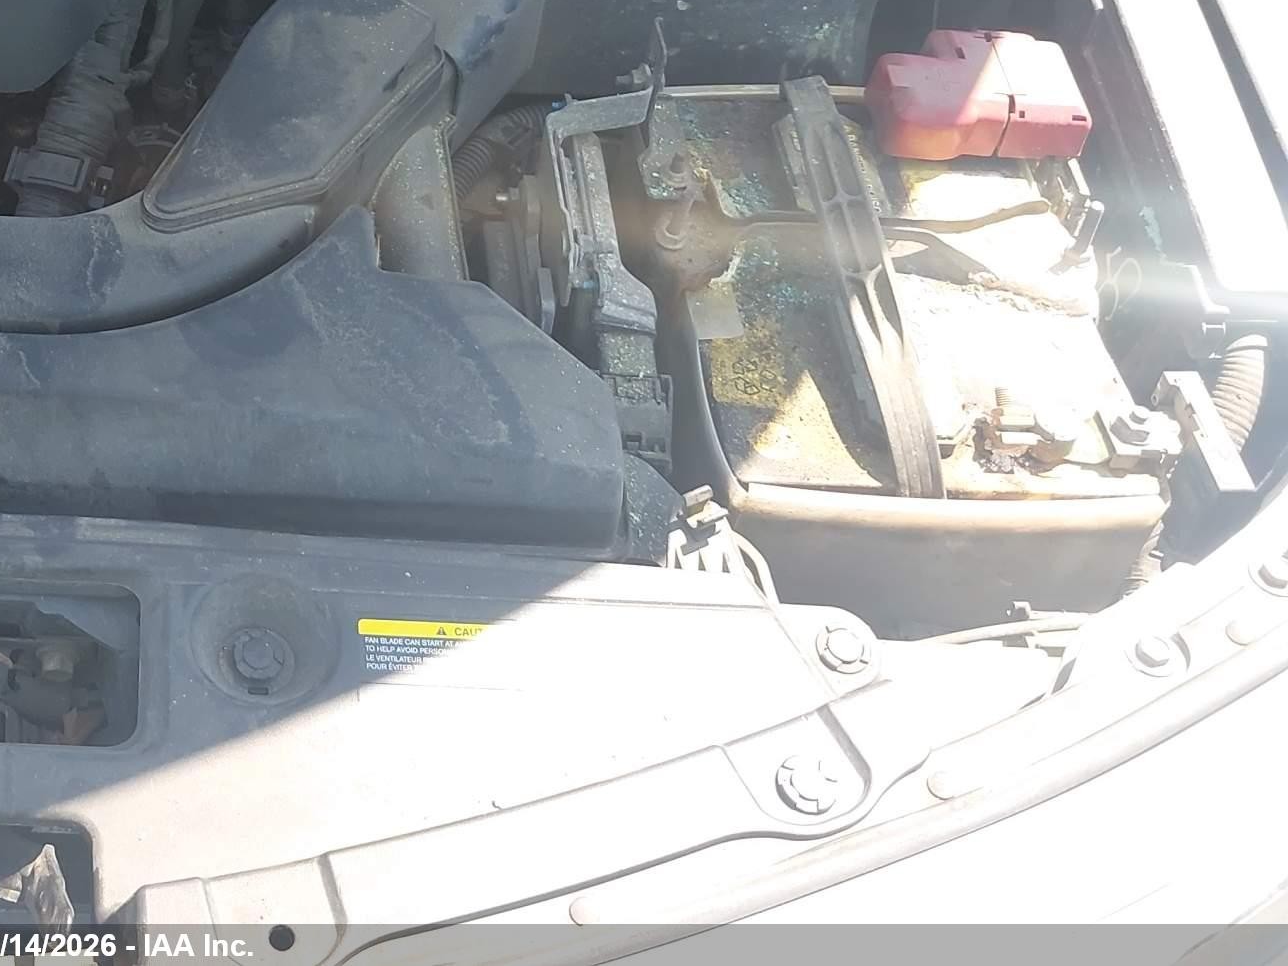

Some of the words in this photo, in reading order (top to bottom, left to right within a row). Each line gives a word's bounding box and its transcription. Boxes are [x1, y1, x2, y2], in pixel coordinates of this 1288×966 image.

[365, 636, 379, 644] FAN
[381, 637, 403, 645] BLADE
[404, 638, 420, 646] CAN
[421, 639, 444, 647] START
[376, 645, 395, 653] HELP
[396, 646, 418, 654] AVOID
[366, 663, 387, 671] POUR
